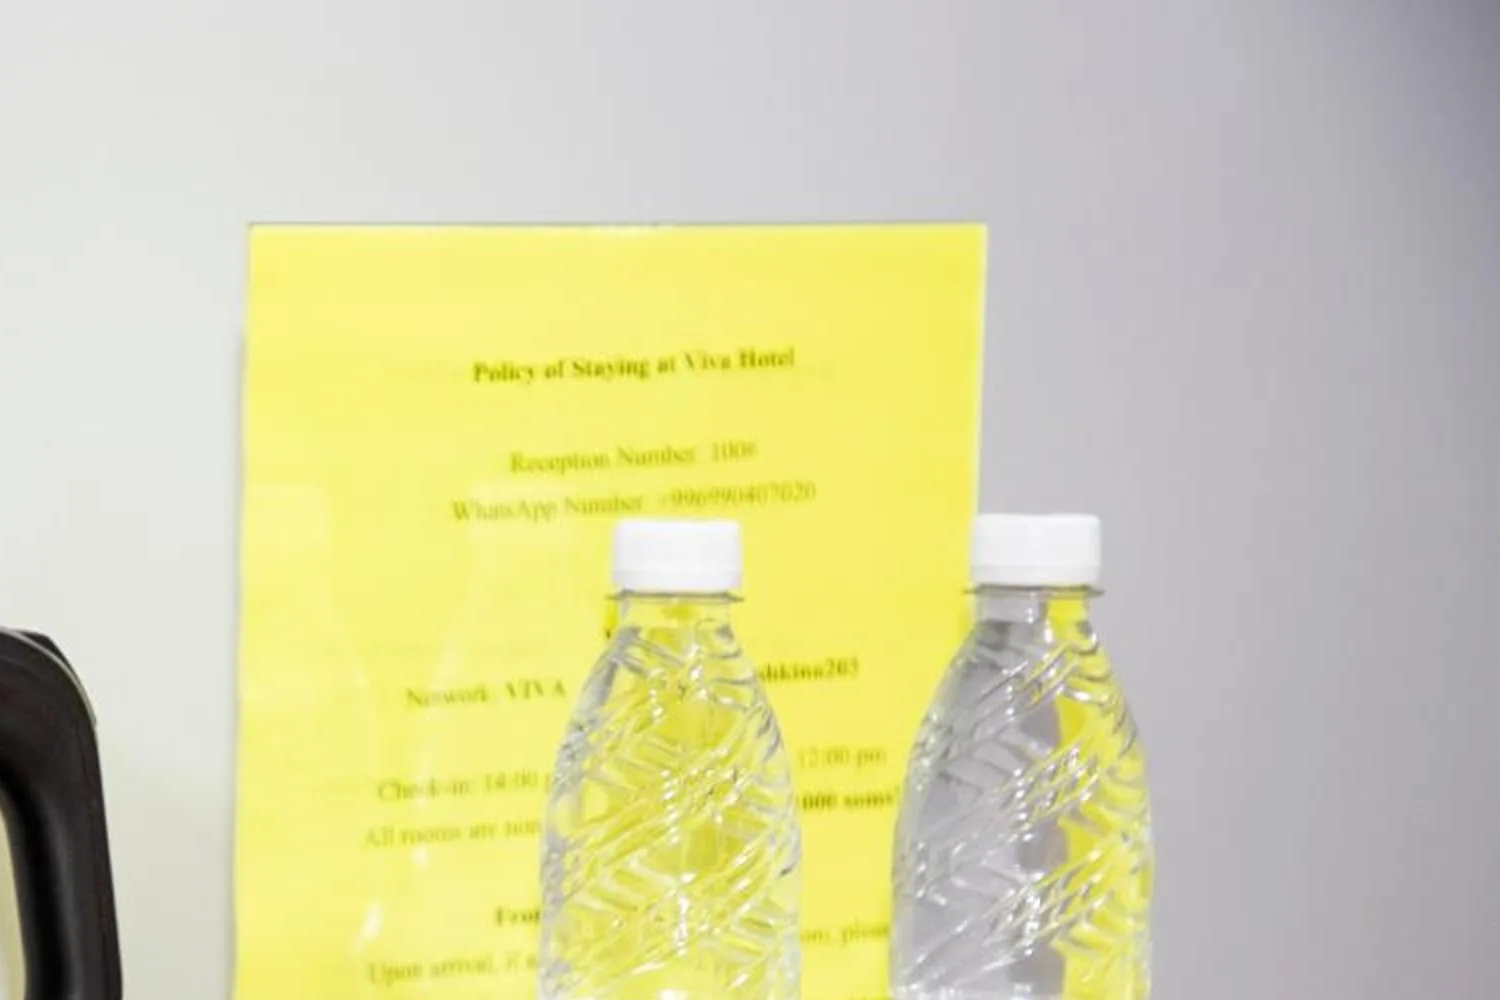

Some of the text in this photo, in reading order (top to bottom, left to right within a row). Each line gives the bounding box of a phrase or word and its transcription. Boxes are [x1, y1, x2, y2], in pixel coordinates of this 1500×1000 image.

[472, 359, 534, 386] Policy
[543, 358, 565, 380] of
[570, 355, 650, 380] Staying
[656, 353, 677, 374] at
[737, 346, 795, 369] Hotel
